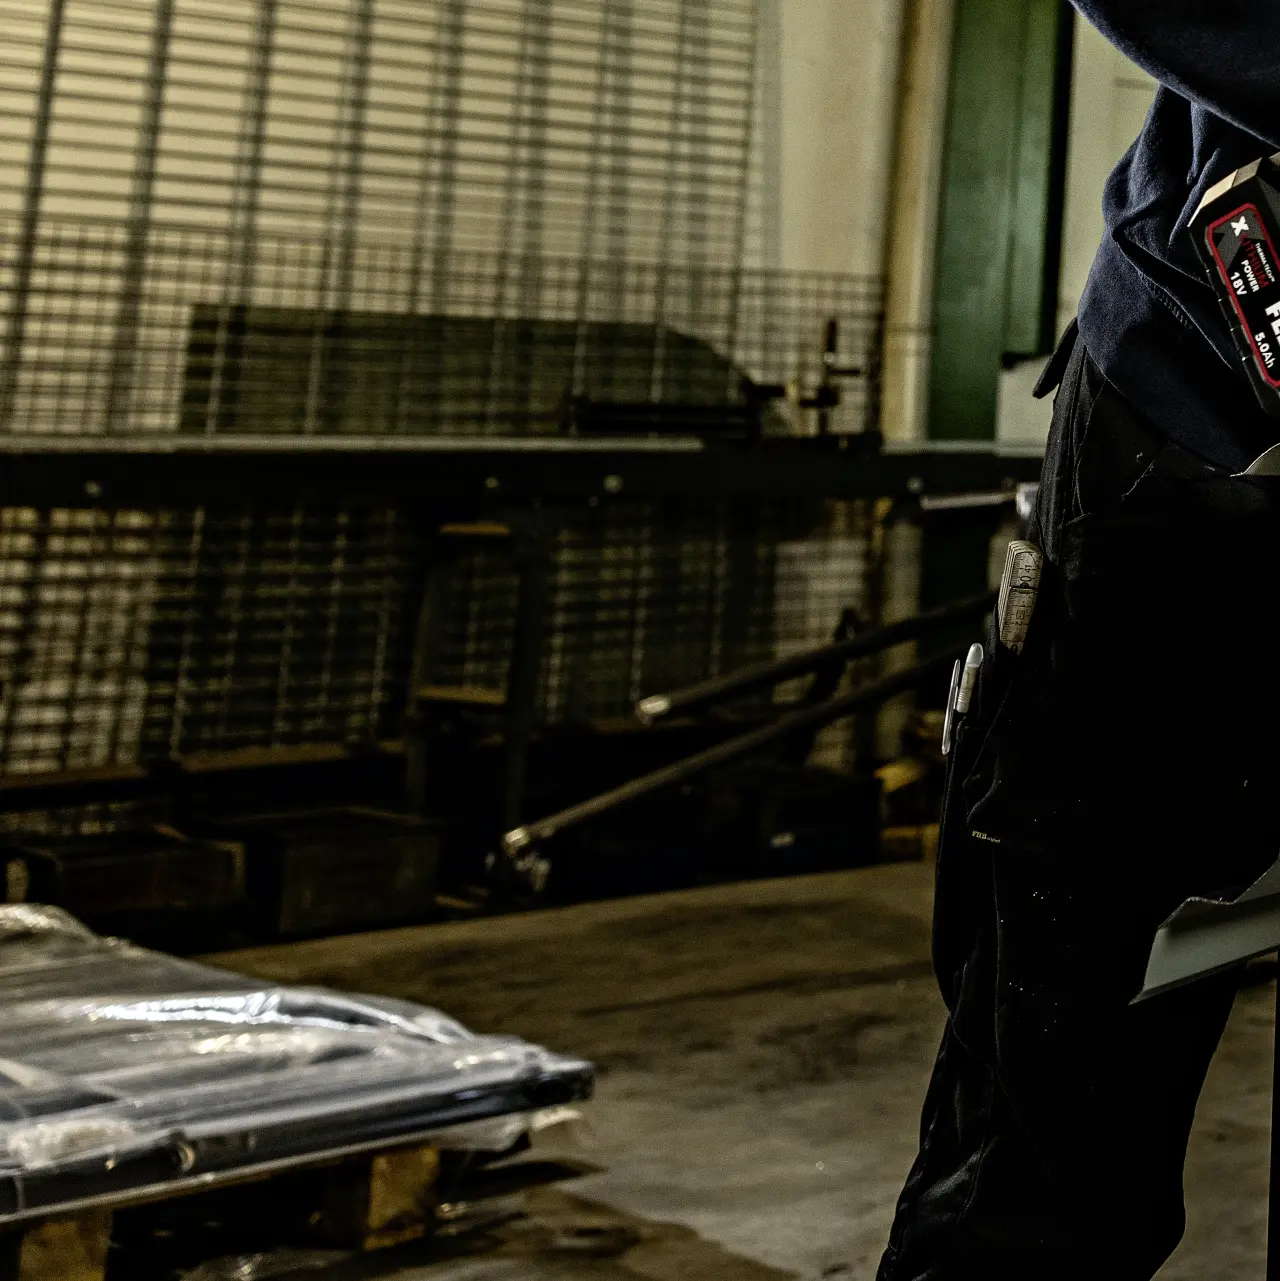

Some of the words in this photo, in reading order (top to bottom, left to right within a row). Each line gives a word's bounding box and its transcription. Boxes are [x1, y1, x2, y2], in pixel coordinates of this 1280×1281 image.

[1230, 271, 1248, 297] 18V
[1241, 259, 1260, 293] POWER
[1254, 331, 1275, 369] 5.0Ah
